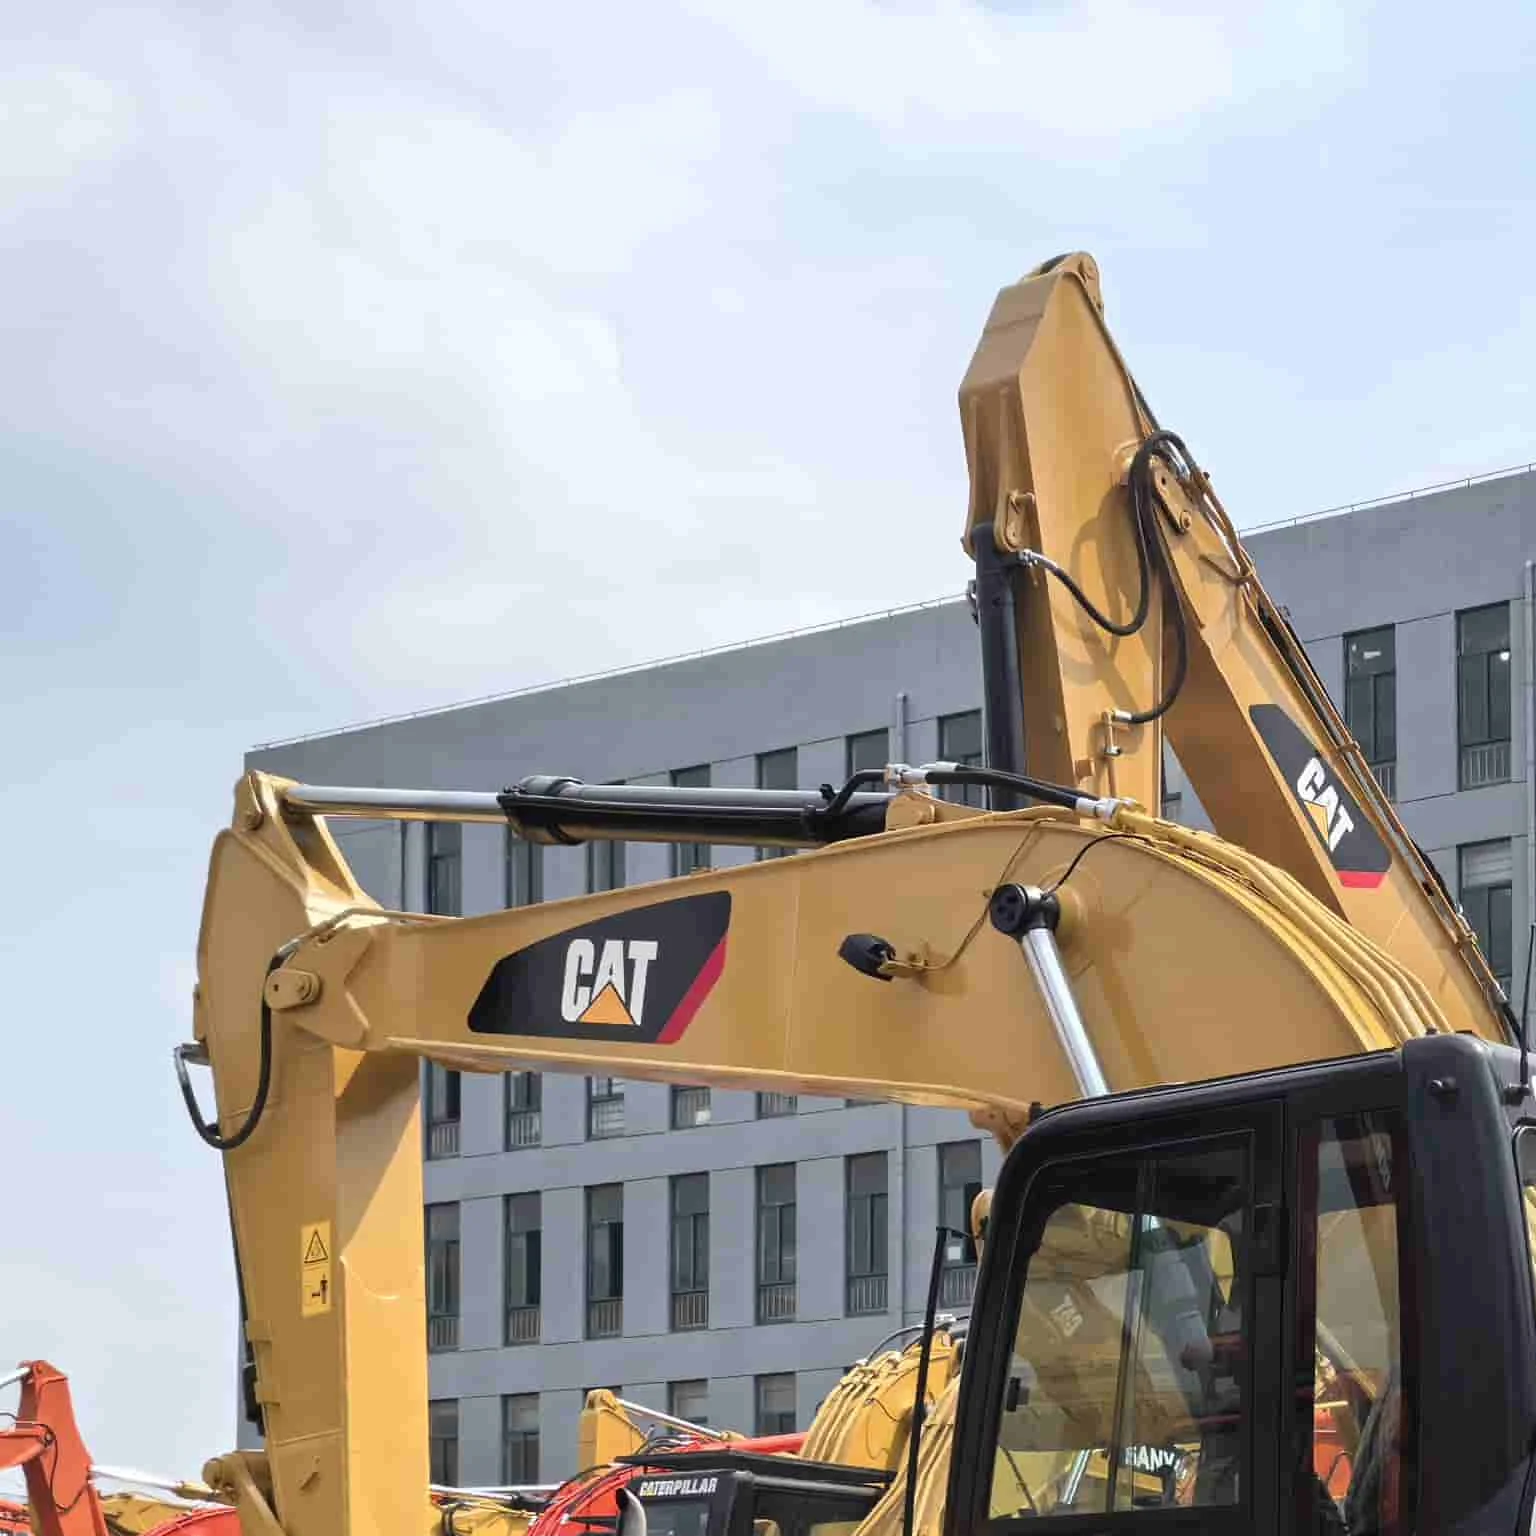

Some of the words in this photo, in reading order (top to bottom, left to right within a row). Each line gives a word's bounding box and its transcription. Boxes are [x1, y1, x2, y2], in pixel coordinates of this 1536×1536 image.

[1297, 757, 1354, 852] CAT
[561, 938, 658, 1026] CAT
[640, 1477, 719, 1496] CATERPILLAR
